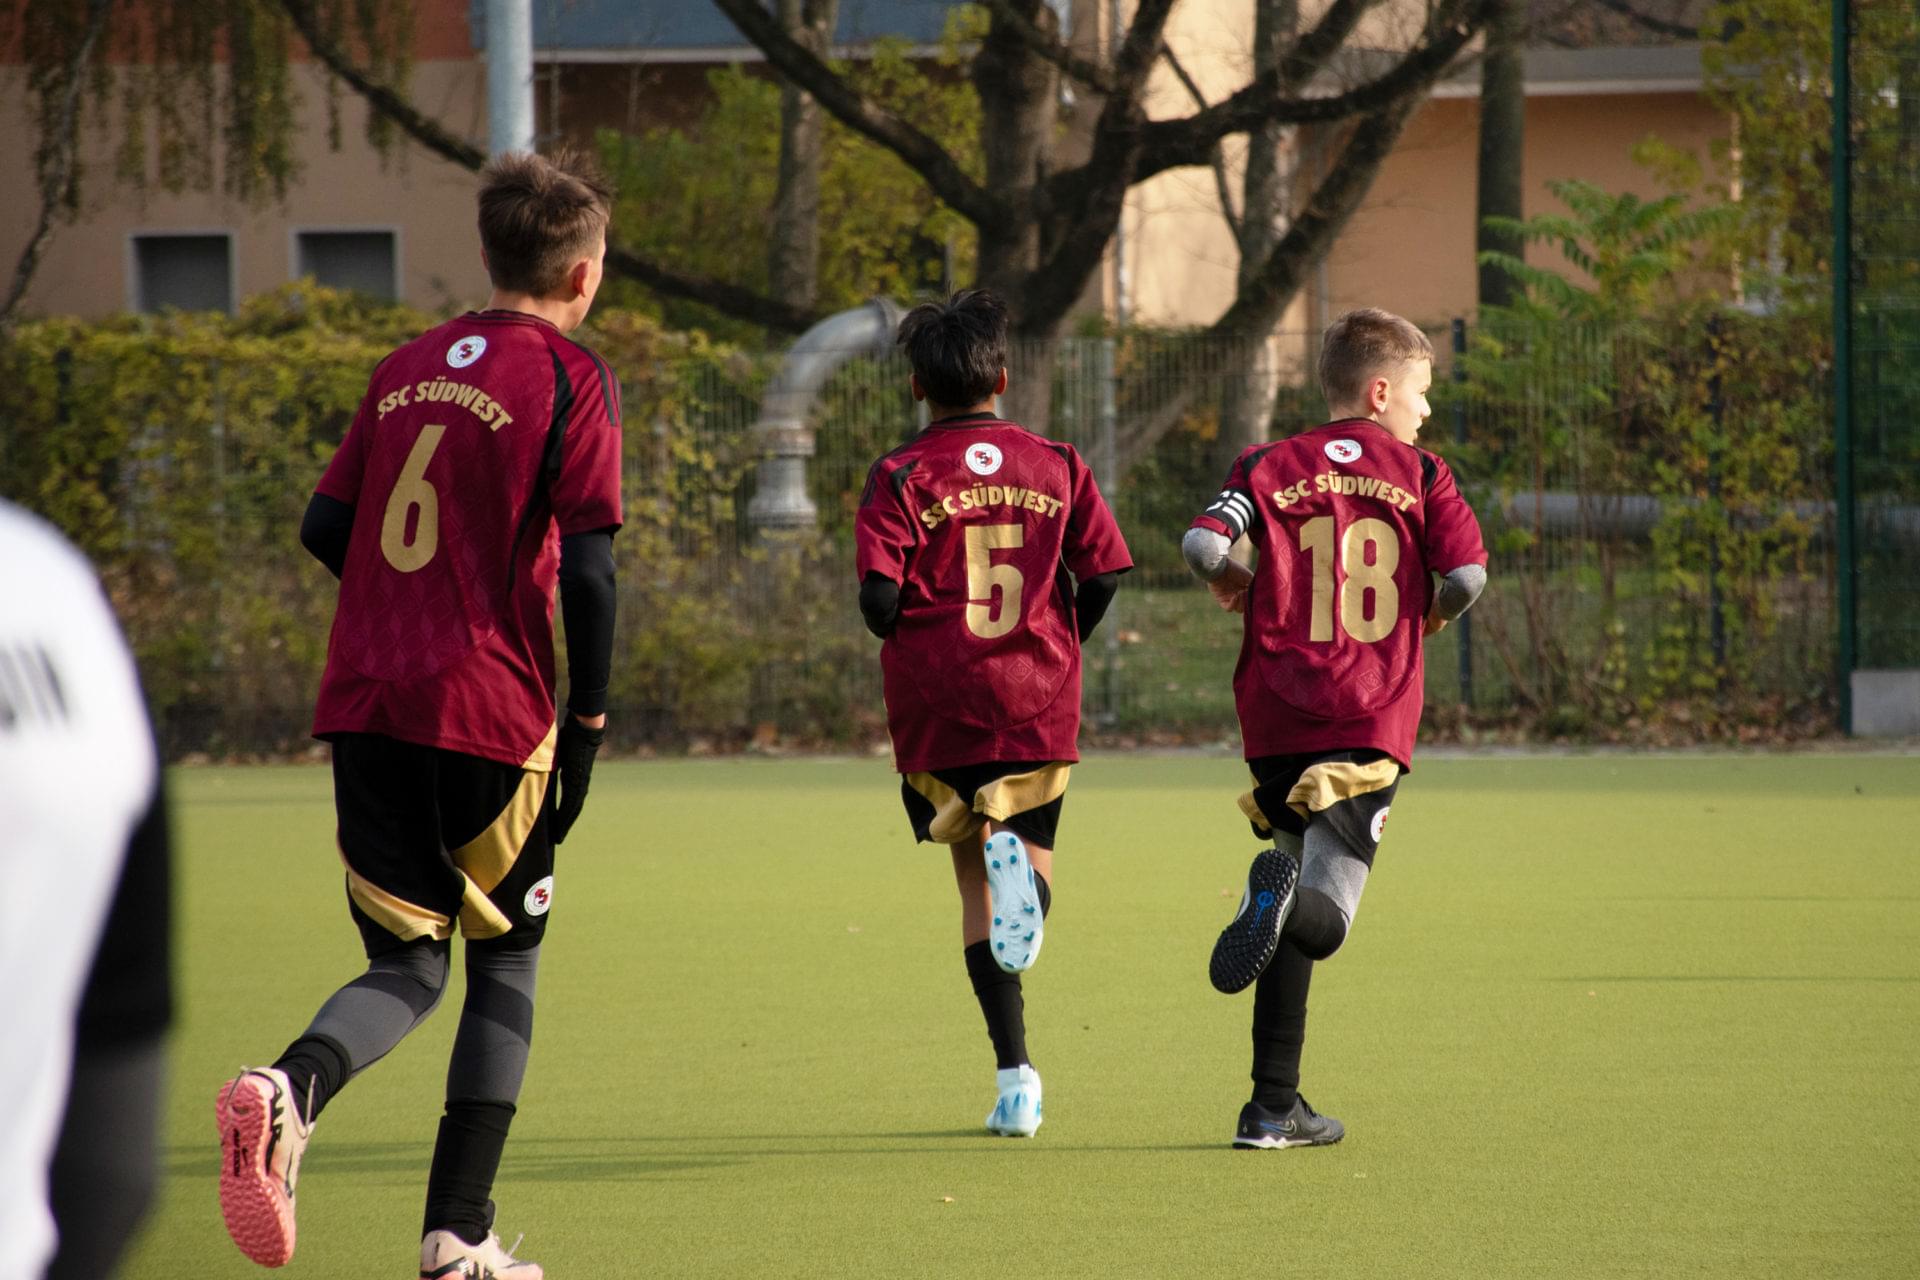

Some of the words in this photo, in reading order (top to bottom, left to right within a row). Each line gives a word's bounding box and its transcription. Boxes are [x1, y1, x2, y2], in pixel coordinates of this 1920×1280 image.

[377, 384, 411, 420] SSC
[414, 376, 513, 432] SÜDWEST
[380, 424, 447, 573] 6
[920, 495, 958, 530] SSC
[959, 483, 1063, 519] SÜDWEST
[1272, 479, 1312, 509] SSC
[1314, 470, 1418, 512] SÜDWEST
[964, 524, 1025, 639] 5
[1298, 515, 1400, 643] 18
